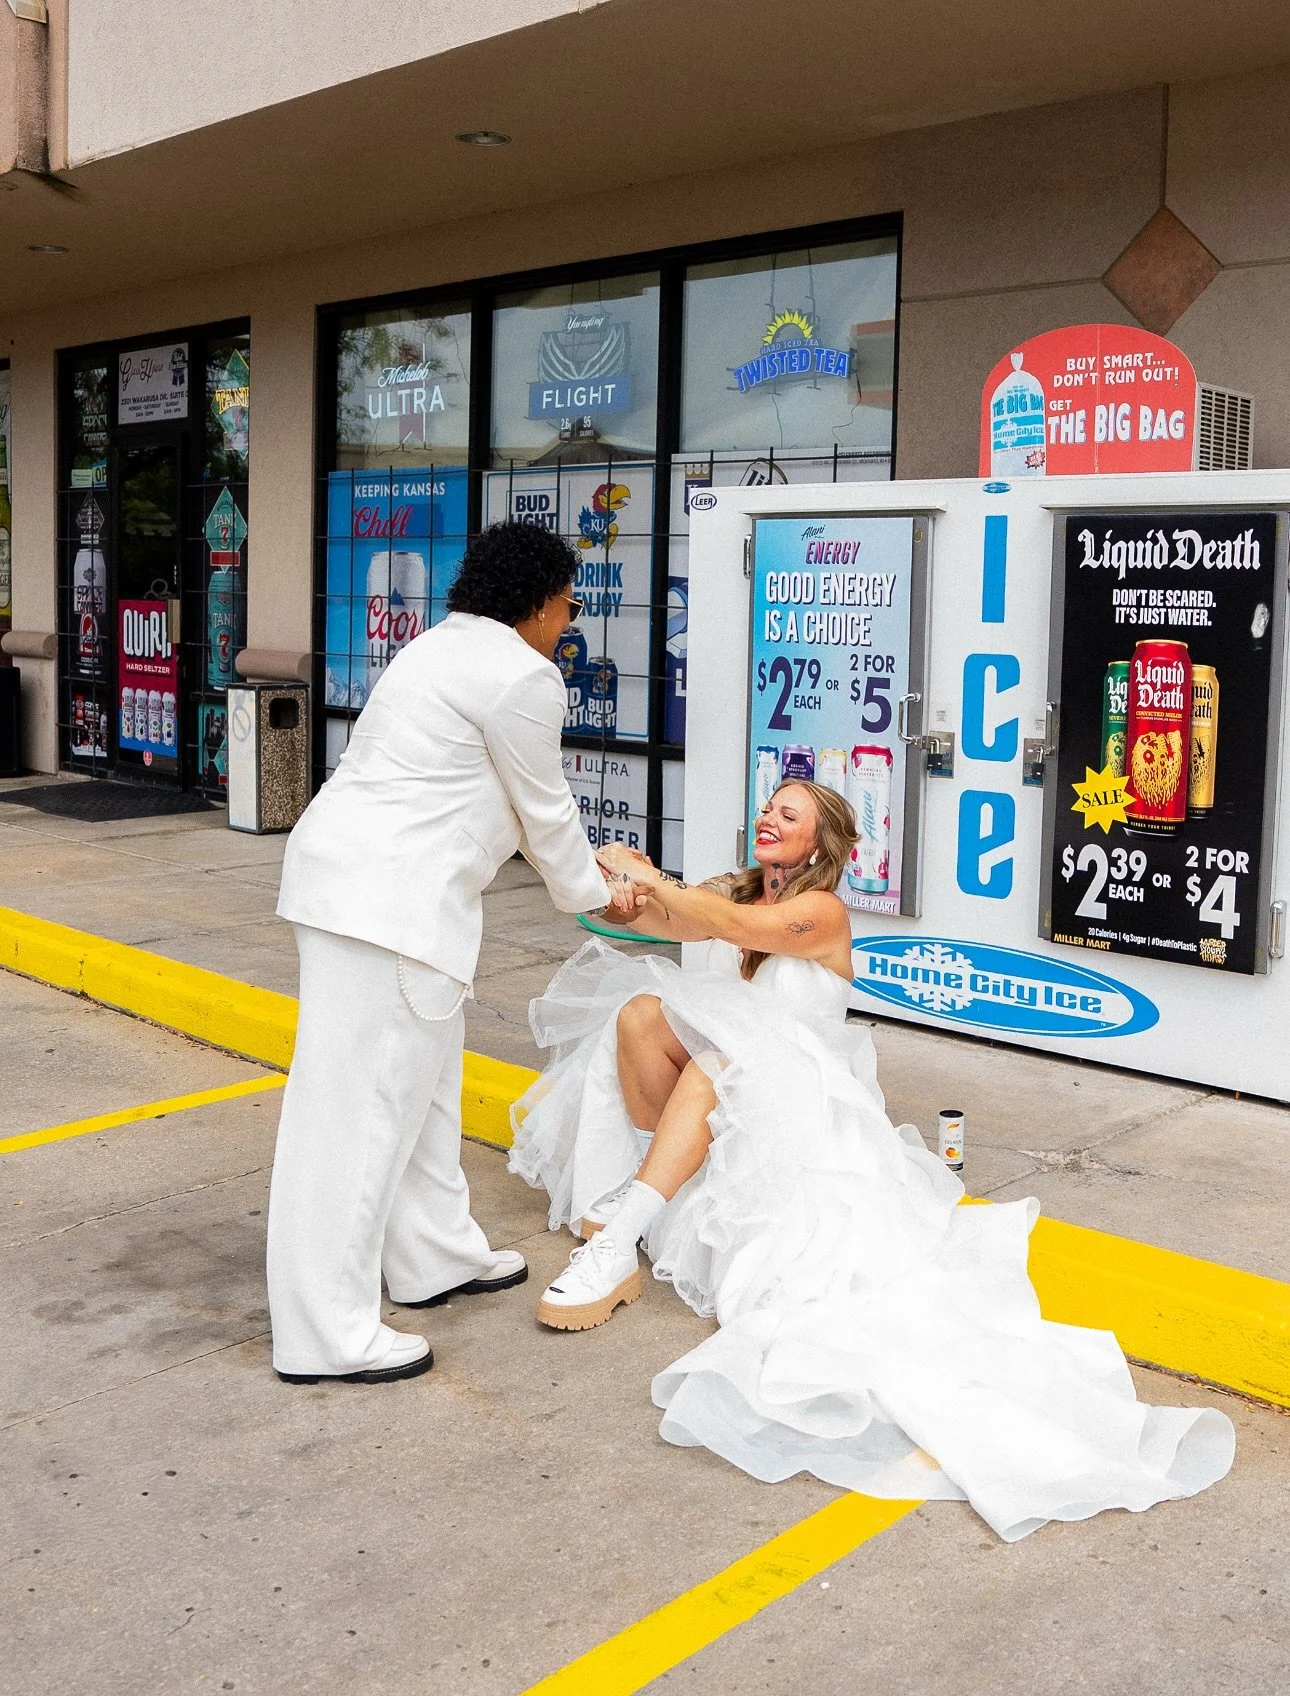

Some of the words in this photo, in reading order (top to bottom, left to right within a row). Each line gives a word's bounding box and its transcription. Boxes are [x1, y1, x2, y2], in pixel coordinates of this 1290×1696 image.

[734, 348, 811, 394] TWISTED
[814, 347, 849, 379] TEA
[1066, 356, 1097, 371] BUY
[1103, 352, 1166, 369] SMART...
[378, 361, 431, 388] Michelob
[1053, 372, 1098, 388] DON'T
[1105, 369, 1135, 385] RUN
[1141, 366, 1179, 382] OUT!
[170, 391, 184, 399] SUITE
[368, 385, 446, 419] ULTRA
[542, 384, 616, 409] FLIGHT
[1006, 393, 1028, 414] BIG
[1049, 399, 1072, 412] GET
[583, 415, 591, 428] 95
[1047, 409, 1088, 445] THE
[1094, 402, 1133, 444] BIG
[1138, 404, 1186, 442] BAG
[95, 465, 107, 483] OP
[354, 484, 400, 499] KEEPING
[403, 482, 446, 497] KANSAS
[694, 494, 714, 507] LEER
[515, 494, 550, 513] BUD
[353, 504, 414, 538] Chill
[591, 518, 604, 533] KU
[801, 524, 826, 541] Alani
[805, 540, 861, 565] ENERGY
[1077, 528, 1170, 581] Liquid
[1170, 528, 1261, 570] Death
[574, 562, 624, 588] DRINK
[765, 571, 816, 605] GOOD
[819, 572, 897, 608] ENERGY
[1112, 588, 1148, 606] DON'T
[1149, 589, 1164, 607] BE
[1165, 590, 1217, 608] SCARED.
[1115, 606, 1138, 624] IT'S
[1138, 607, 1167, 625] JUST
[1167, 608, 1212, 626] WATER.
[764, 609, 783, 643] IS
[785, 610, 799, 643] A
[803, 610, 873, 647] CHOICE
[126, 663, 143, 672] HARD
[144, 664, 170, 674] SELTZER
[850, 653, 859, 672] 2
[864, 654, 896, 673] FOR
[1135, 659, 1185, 689] Liquid
[1107, 676, 1128, 698] Liq
[1137, 683, 1184, 711] Death
[588, 697, 614, 714] BUD
[793, 695, 822, 711] EACH
[825, 679, 839, 691] OR
[850, 676, 892, 734] $5
[585, 709, 617, 728] LIGHT
[1135, 710, 1165, 718] CONVICTED
[584, 758, 629, 777] ULTRA
[1081, 788, 1124, 809] SALE
[587, 824, 639, 852] BEER
[1185, 845, 1199, 868] 2
[1205, 847, 1250, 874] FOR
[1152, 873, 1171, 889] OR
[1108, 884, 1144, 903] EACH
[872, 901, 896, 914] MART
[1185, 872, 1241, 940] $4
[1054, 933, 1084, 947] MILLER
[1086, 937, 1111, 951] MART
[1088, 927, 1095, 936] 20
[1095, 929, 1118, 940] Calories
[1122, 932, 1129, 943] 4g
[1129, 933, 1146, 945] Sugar
[1151, 937, 1198, 952] #DeathToPlastic
[868, 955, 965, 989] Home
[970, 975, 1037, 1004] City
[1045, 991, 1102, 1014] Ice
